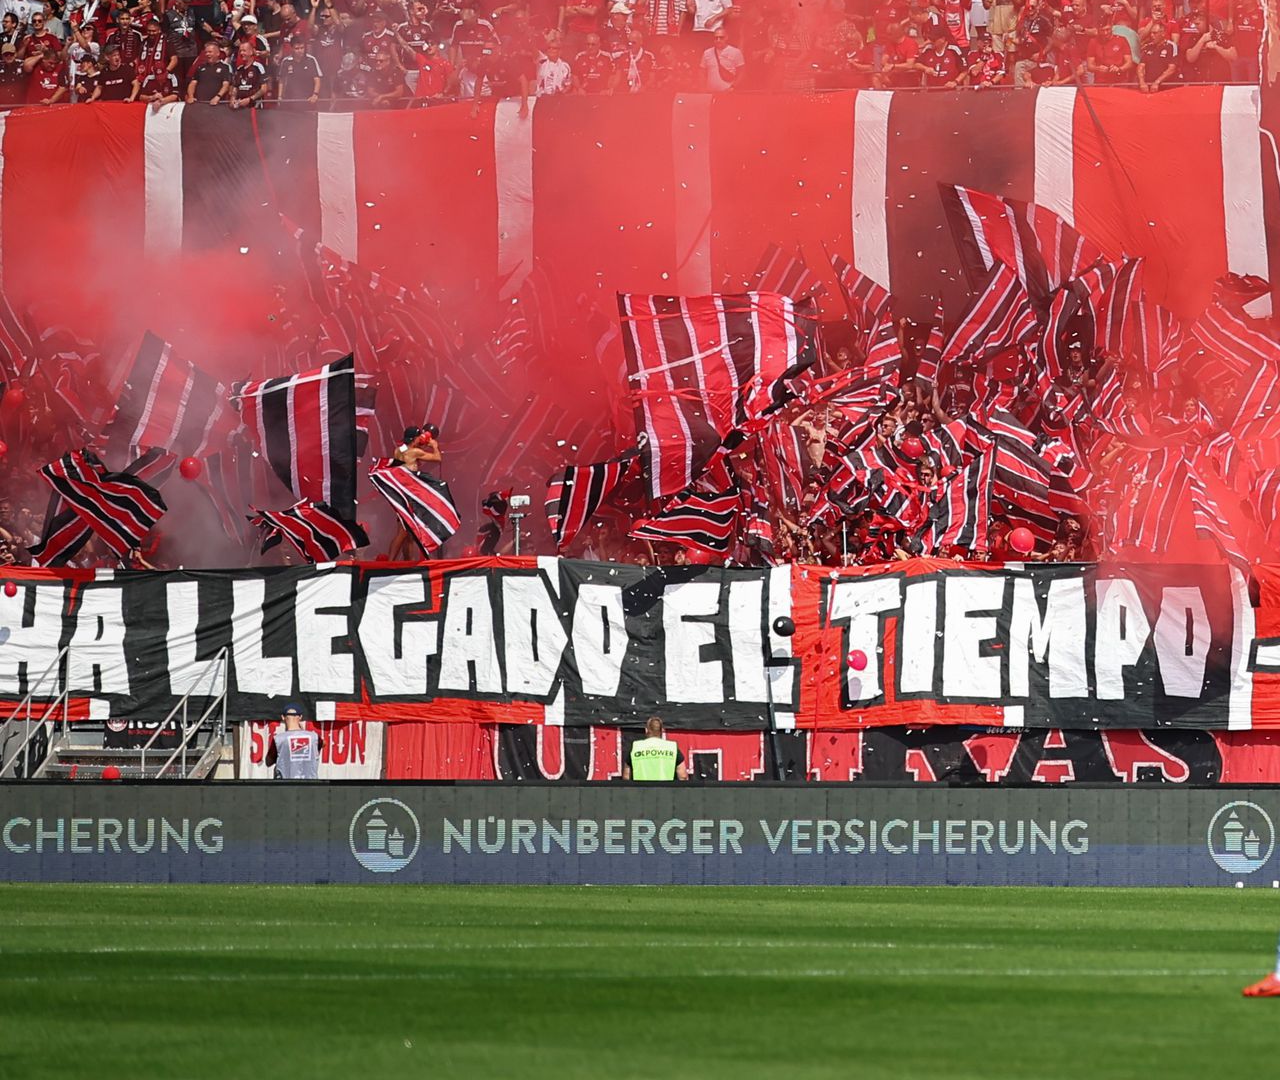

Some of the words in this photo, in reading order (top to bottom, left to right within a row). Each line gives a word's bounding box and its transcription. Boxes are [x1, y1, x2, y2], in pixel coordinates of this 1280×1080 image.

[0, 580, 131, 697] HA
[166, 572, 629, 698] LLEGADO
[662, 579, 795, 703] EL
[829, 574, 1213, 703] TIEMPO
[2, 816, 225, 854] CHERUNG
[442, 815, 745, 855] NÜRNBERGER
[760, 818, 1090, 855] VERSICHERUNG
